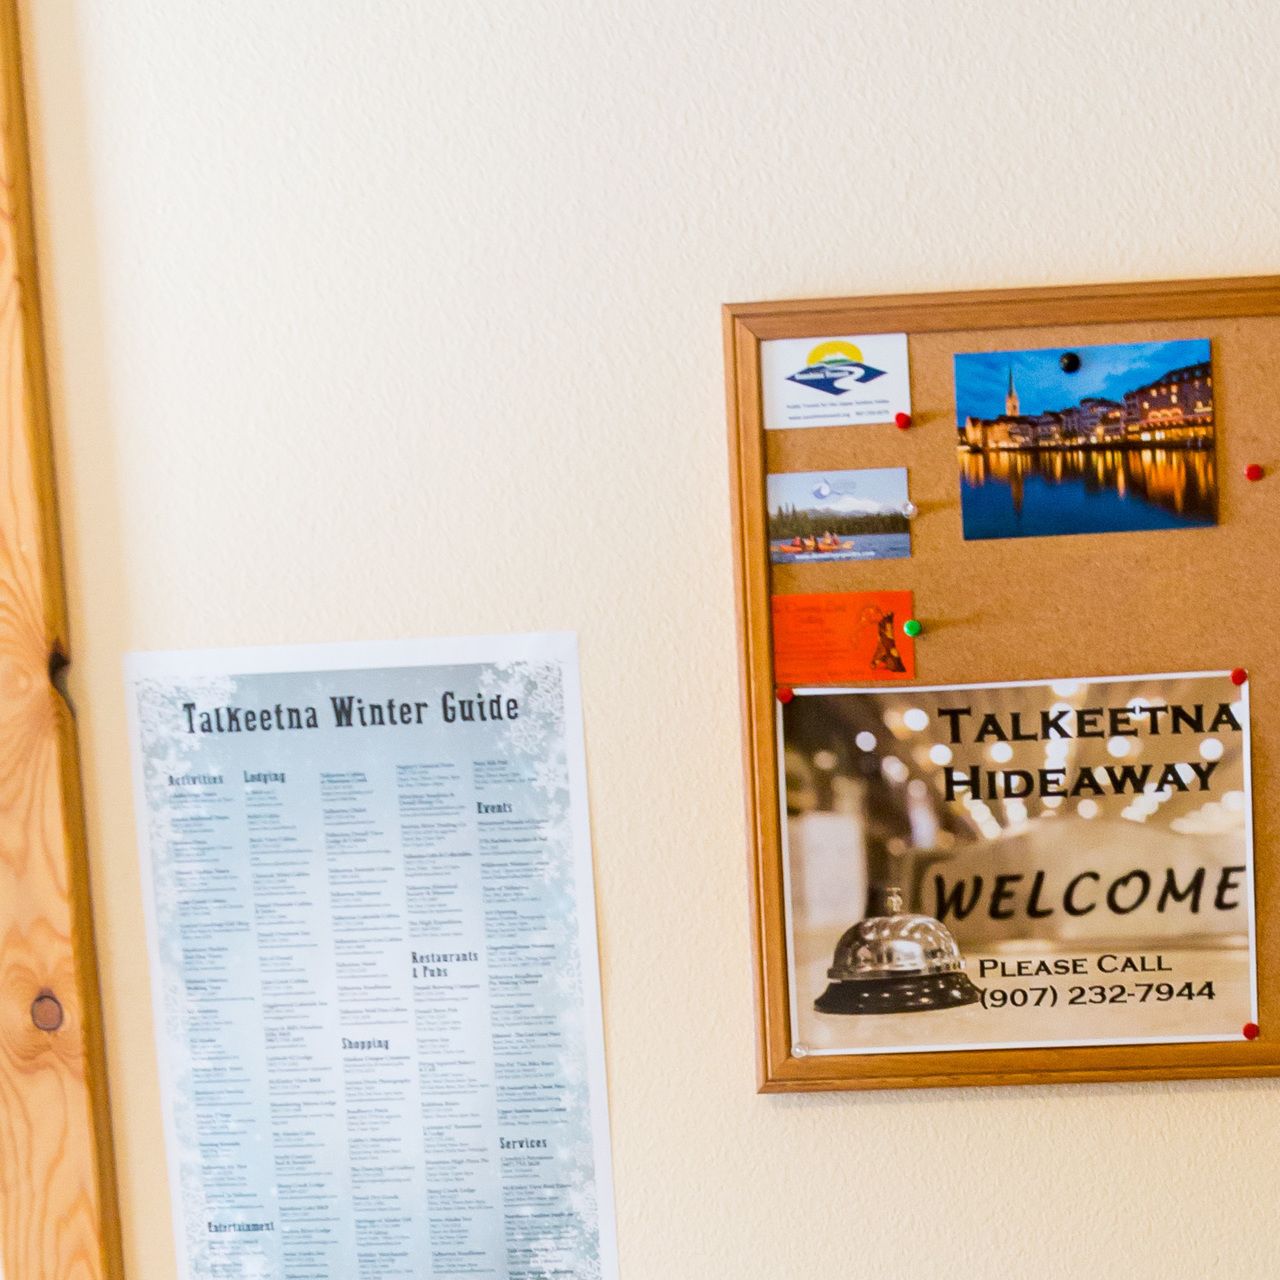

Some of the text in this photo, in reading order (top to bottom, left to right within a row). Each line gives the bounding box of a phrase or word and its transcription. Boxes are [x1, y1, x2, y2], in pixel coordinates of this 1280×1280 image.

[329, 695, 429, 728] Winter
[442, 691, 520, 723] Guide
[937, 703, 1242, 744] TALKEETNA
[944, 761, 1221, 802] HIDEAWAY
[476, 802, 513, 814] Events
[934, 865, 1247, 922] WELCOME
[410, 951, 479, 964] Restaurants
[978, 954, 1173, 978] PLEASE CALL
[422, 966, 448, 978] Pubs
[980, 981, 1216, 1010] (907) 232-7944
[341, 1037, 390, 1051] Shopping
[499, 1137, 548, 1150] Services
